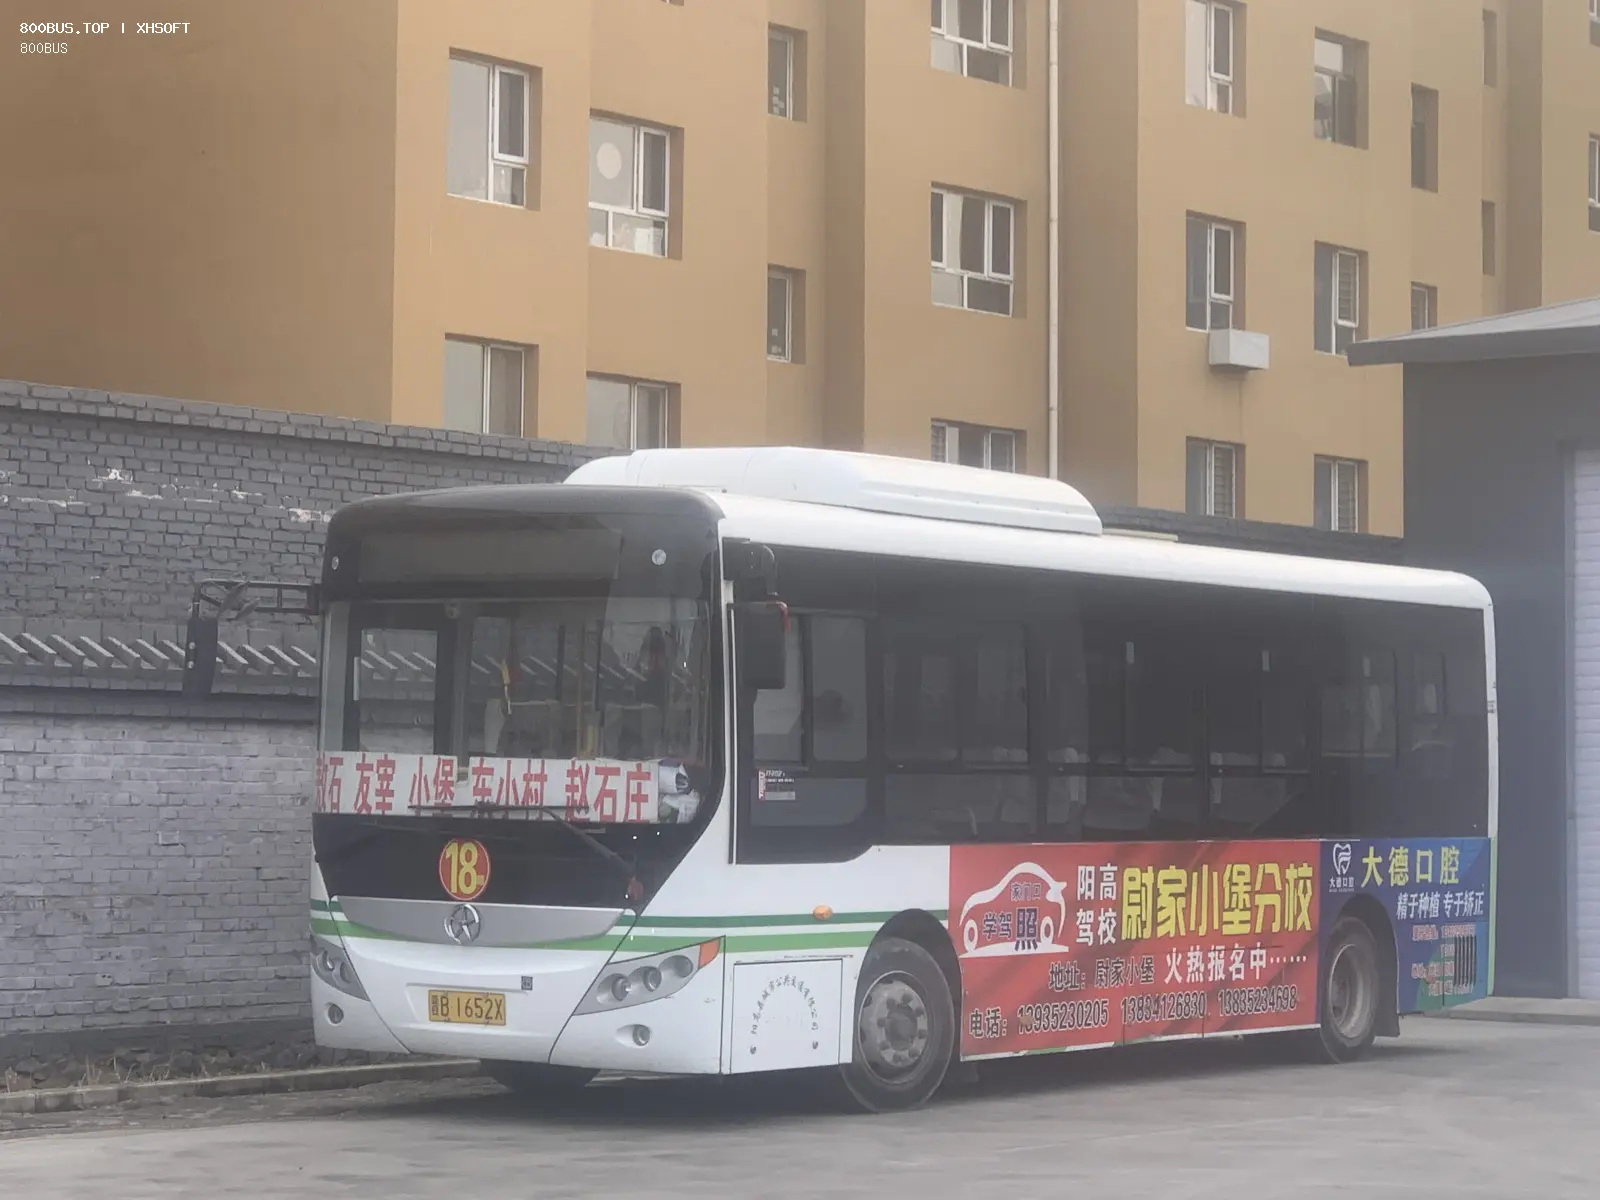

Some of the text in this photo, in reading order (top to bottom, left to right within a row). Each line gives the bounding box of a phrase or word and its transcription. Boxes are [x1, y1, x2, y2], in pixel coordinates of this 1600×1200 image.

[353, 752, 396, 815] 友宰
[408, 756, 456, 817] 小堡
[564, 757, 653, 823] 赵石庄
[445, 841, 478, 895] 18
[1076, 862, 1118, 901] 阳高
[1360, 845, 1461, 888] 大德口腔
[1121, 862, 1314, 941] 尉家小堡分校
[1396, 889, 1485, 920] 精于种植 专于矫正
[982, 906, 1039, 951] 学驾照
[1075, 907, 1117, 946] 驾校
[1094, 954, 1155, 990] 尉家小堡
[1016, 998, 1110, 1036] 13935230205
[1120, 990, 1208, 1026] 13834126830
[1217, 984, 1298, 1018] 13835234698
